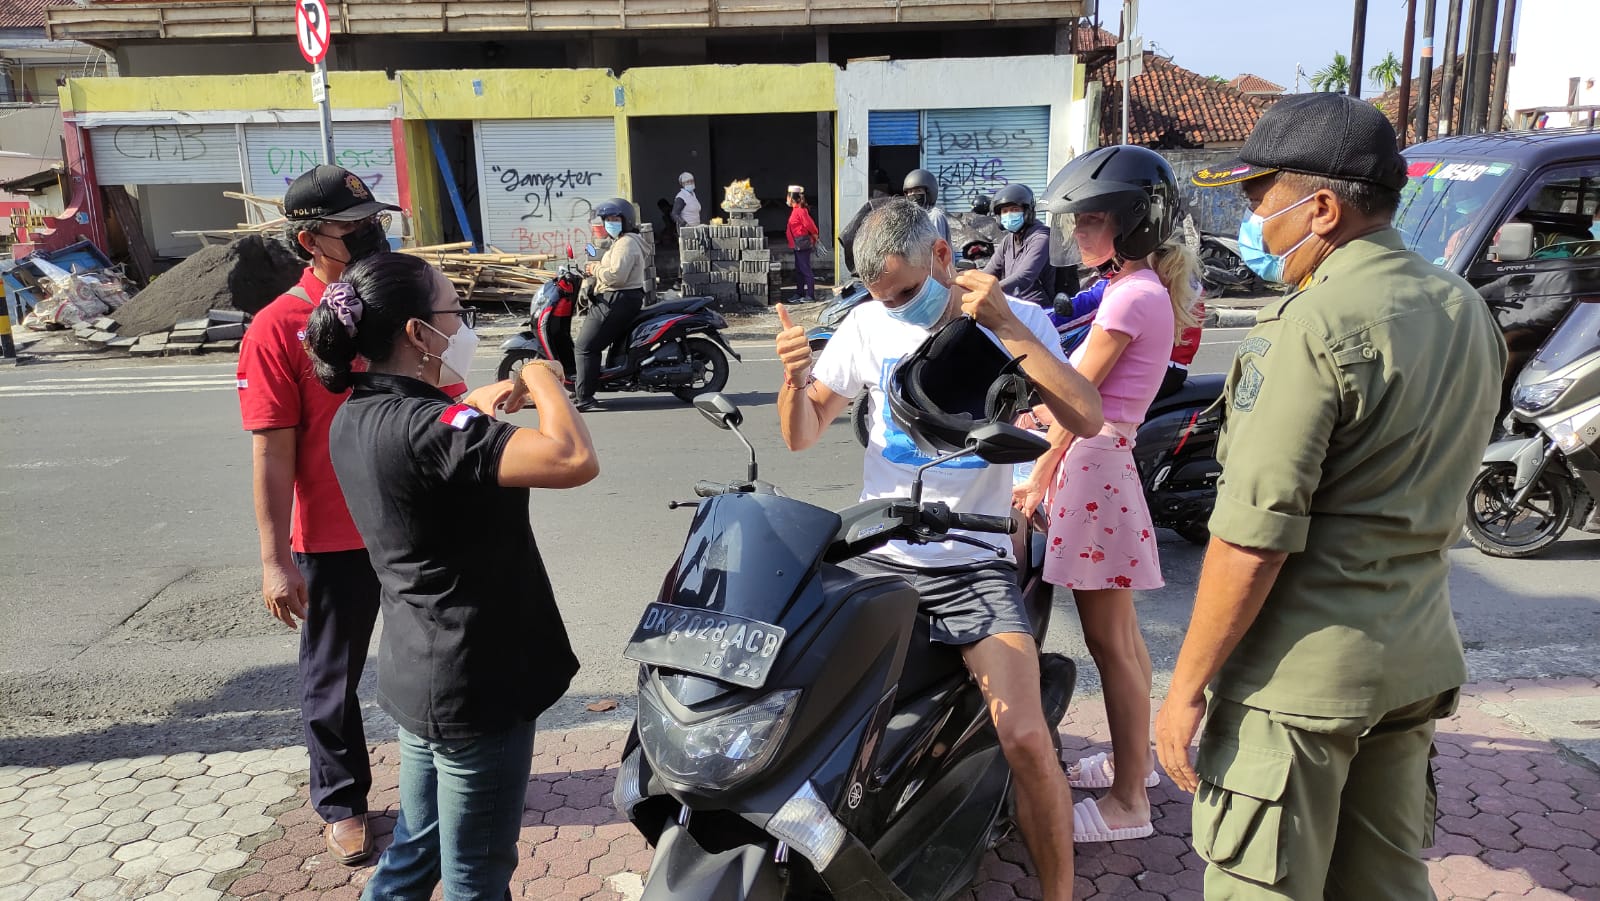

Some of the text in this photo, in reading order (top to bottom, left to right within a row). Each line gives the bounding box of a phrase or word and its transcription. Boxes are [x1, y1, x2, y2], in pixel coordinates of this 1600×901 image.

[643, 607, 779, 658] DK 2028 ACB
